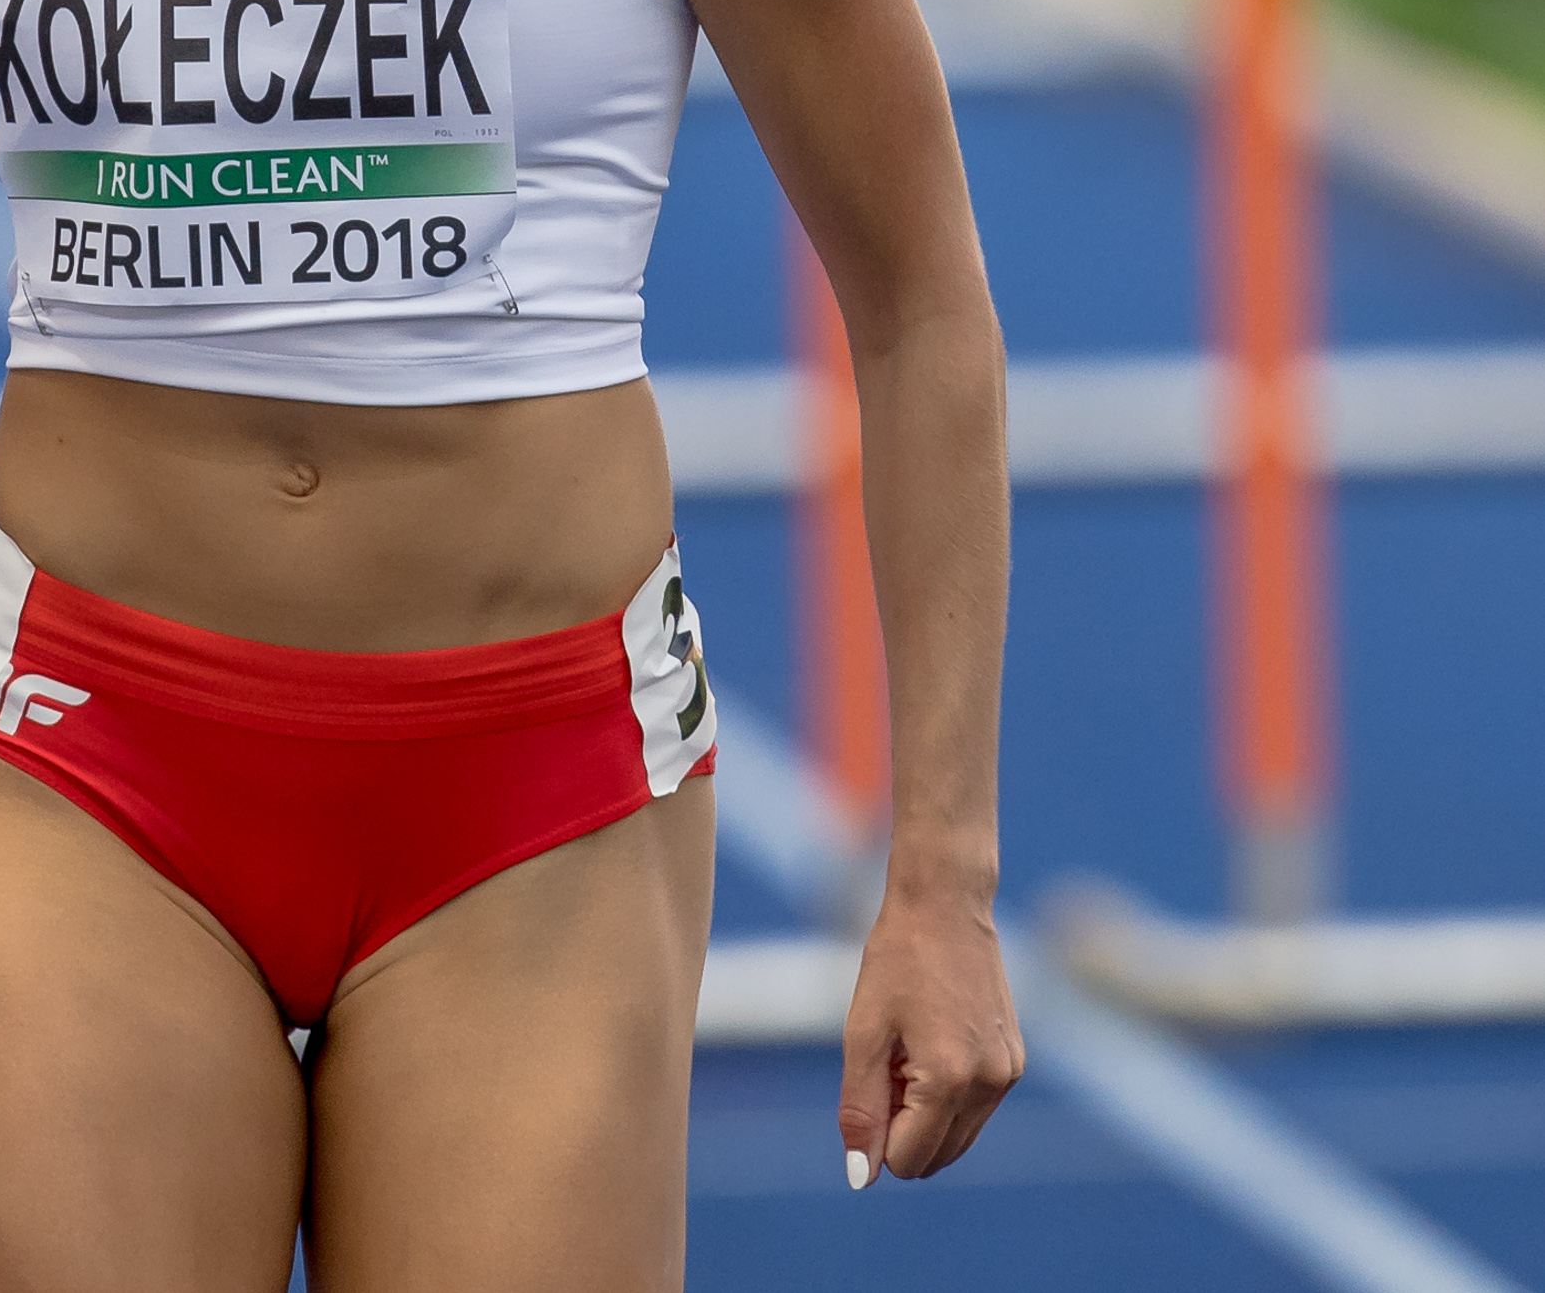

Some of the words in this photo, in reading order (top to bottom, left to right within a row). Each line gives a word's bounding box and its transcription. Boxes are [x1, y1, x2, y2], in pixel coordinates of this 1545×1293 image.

[434, 129, 454, 138] POL
[96, 159, 105, 196] I
[111, 161, 194, 199] RUN
[50, 216, 263, 289] BERLIN
[290, 215, 468, 284] 2018
